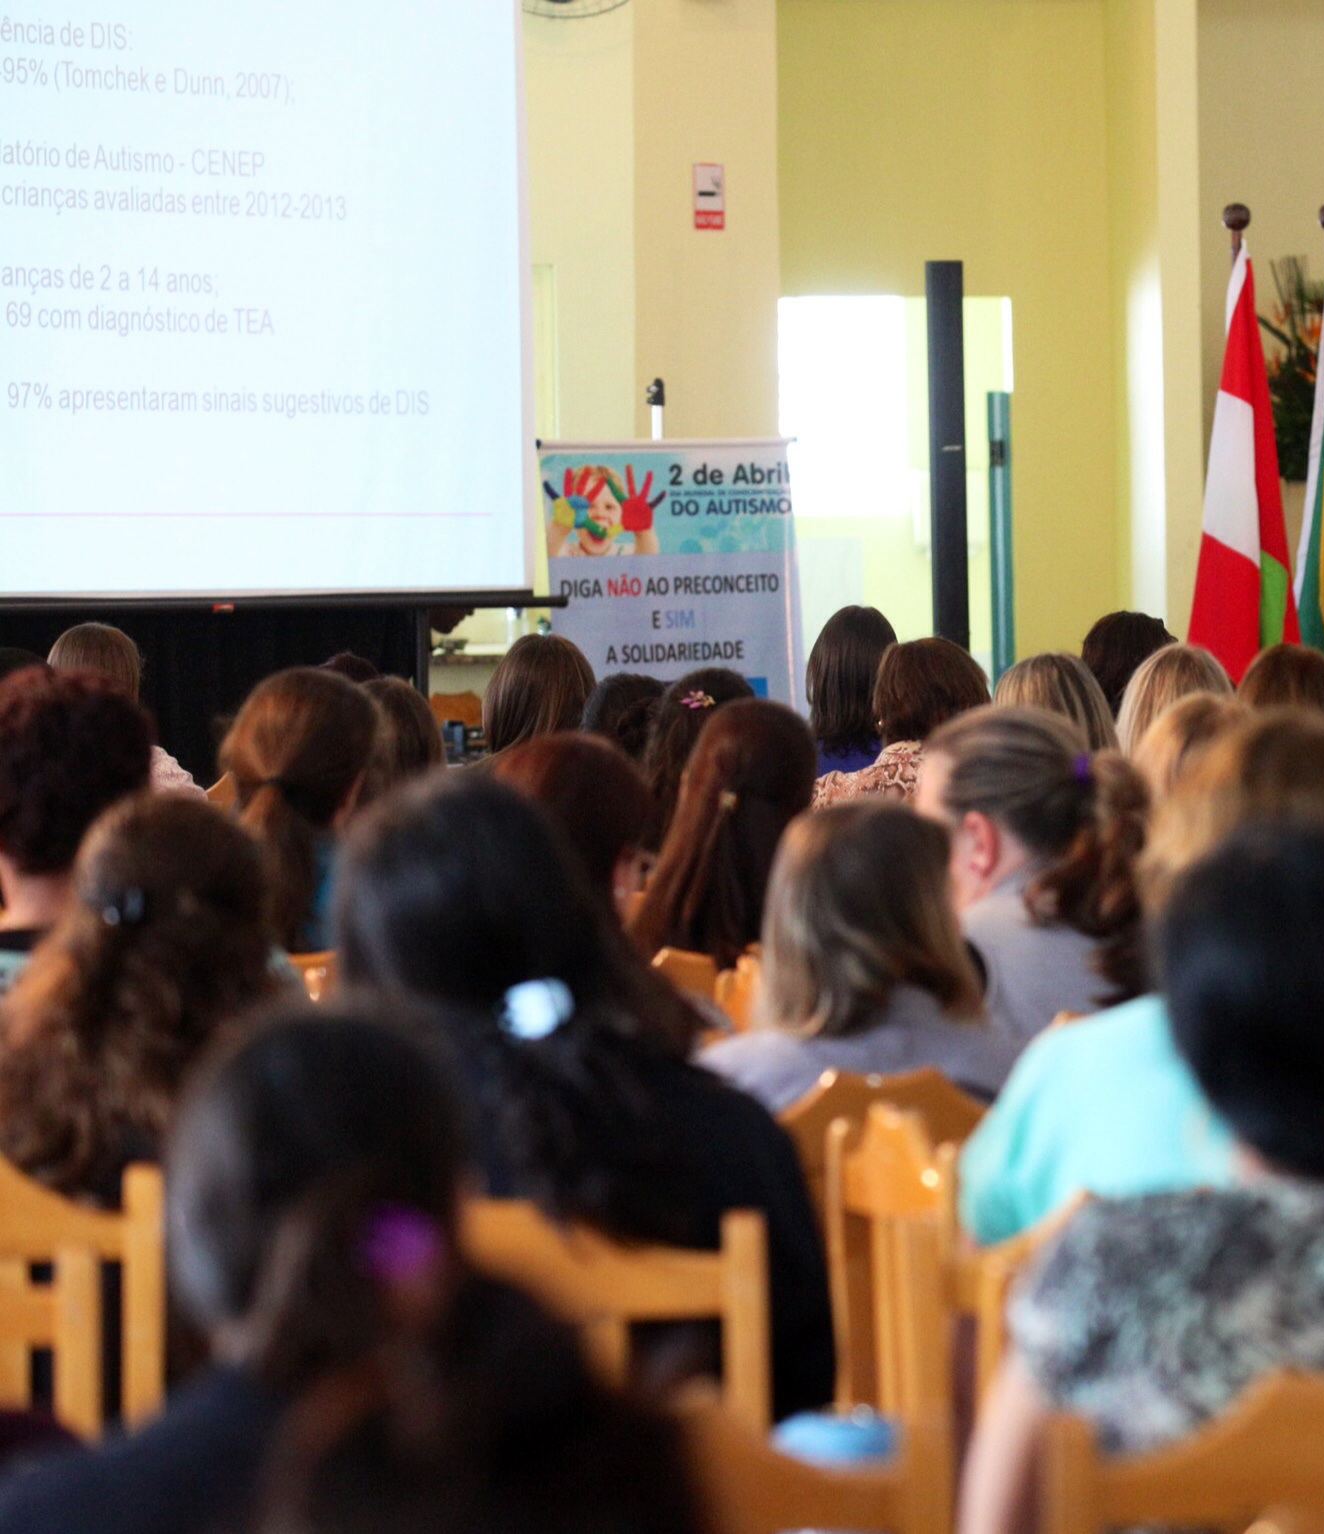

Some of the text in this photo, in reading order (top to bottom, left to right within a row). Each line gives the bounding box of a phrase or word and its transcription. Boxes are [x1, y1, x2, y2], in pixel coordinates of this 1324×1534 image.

[60, 21, 85, 47] de
[90, 21, 133, 51] DIS:
[54, 60, 150, 94] (Tomchek
[155, 71, 167, 93] e
[173, 68, 230, 101] Dunn,
[65, 141, 90, 169] de
[93, 143, 175, 174] Autismo
[191, 147, 266, 177] CENEP
[1, 178, 348, 221] crianças avaliadas entre 2012-2013
[69, 263, 94, 290] de
[99, 264, 111, 291] 2
[117, 272, 130, 292] a
[137, 266, 160, 293] 14
[5, 300, 275, 337] 69 com diagnóstico de TEA
[7, 381, 430, 419] 97% apresentaram sinais sugestivos de DIS
[669, 463, 683, 486] 2
[692, 462, 724, 486] de
[670, 497, 793, 517] DO AUTISMO
[560, 573, 779, 598] DIGA NÃO AO PRECONCEITO
[652, 609, 696, 630] E SIM
[605, 640, 745, 664] A SOLIDARIEDADE
